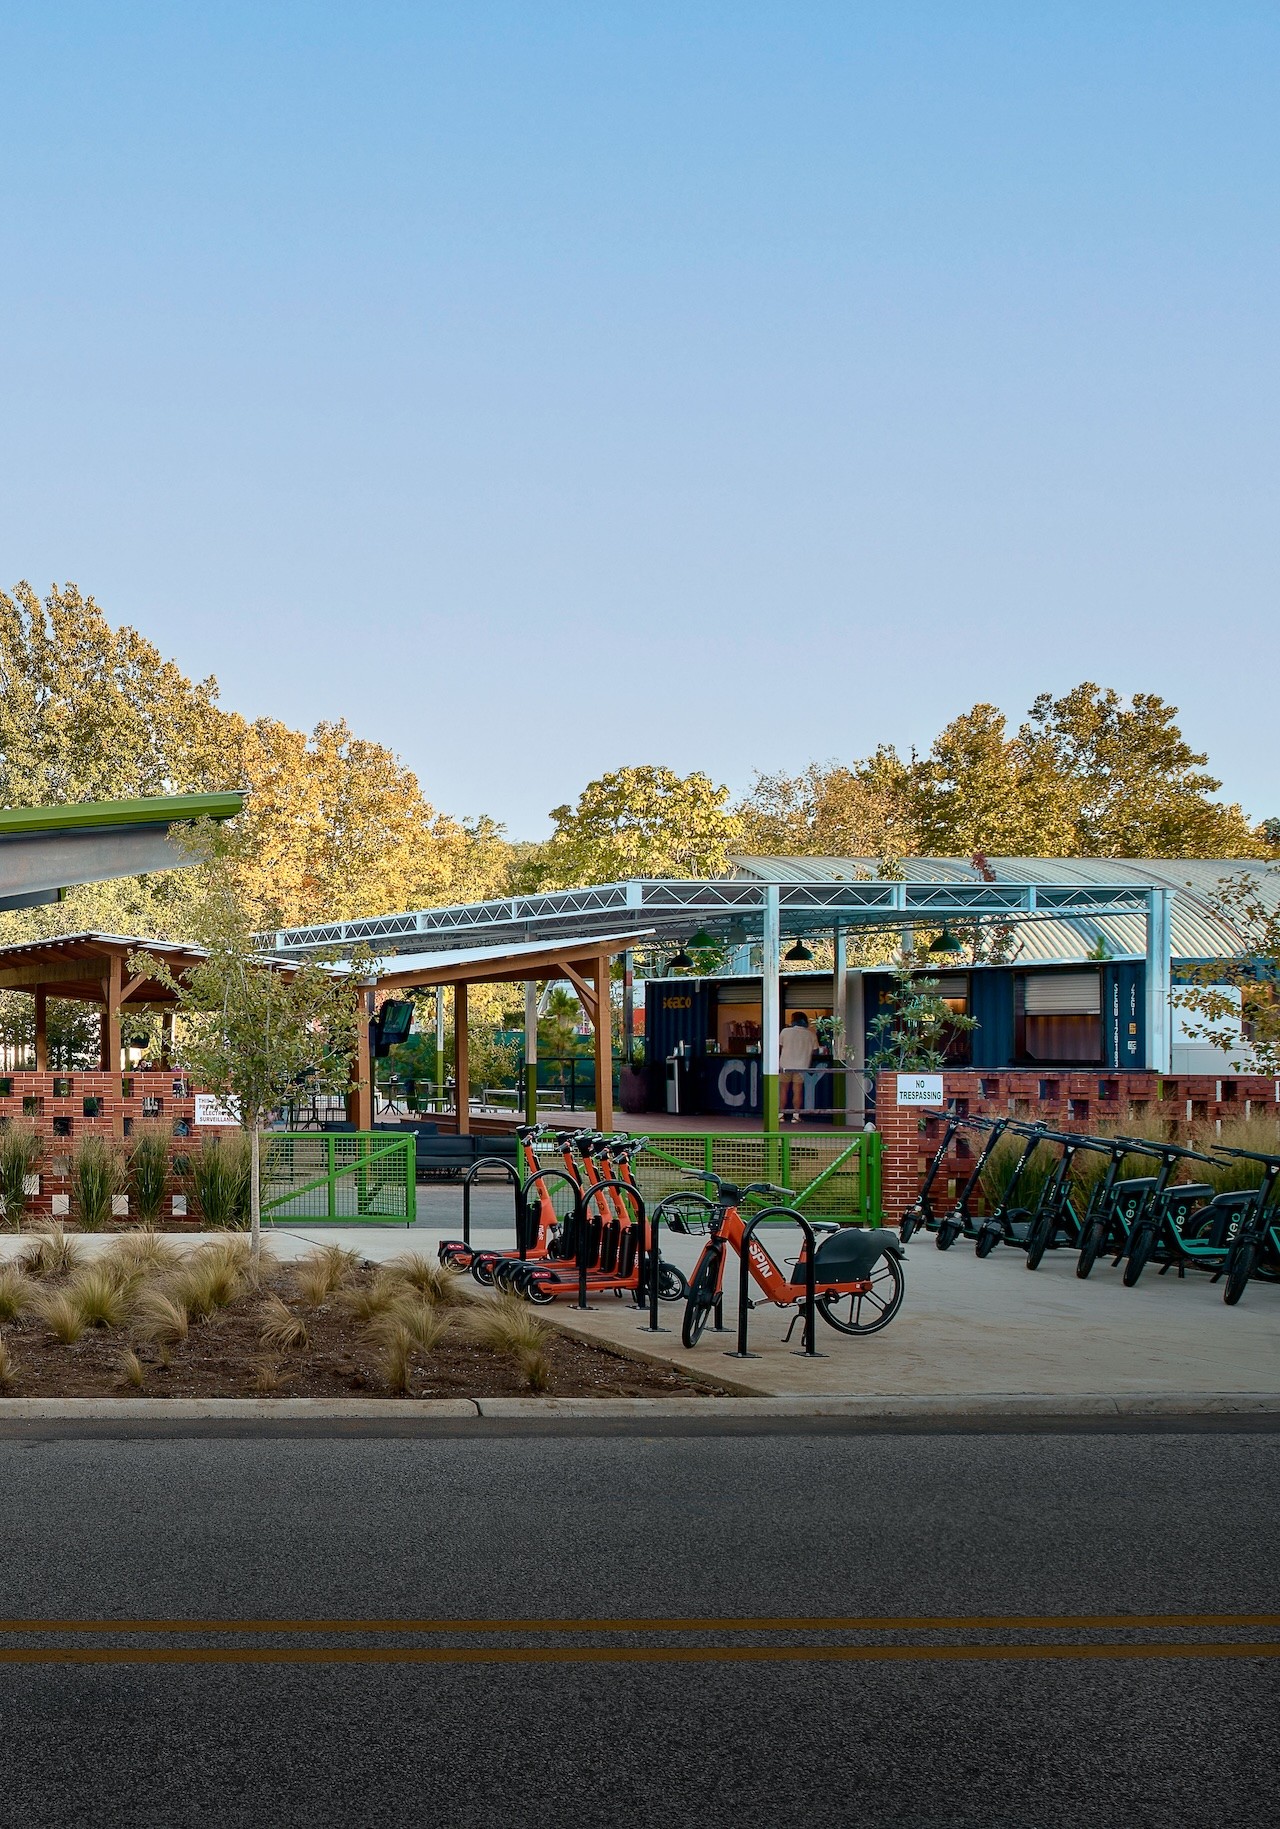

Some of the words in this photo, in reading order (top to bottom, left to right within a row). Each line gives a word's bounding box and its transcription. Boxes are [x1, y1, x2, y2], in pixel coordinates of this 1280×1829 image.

[718, 1059, 829, 1110] CIY
[899, 1091, 942, 1100] TRESPASSING
[915, 1080, 925, 1088] NO
[1226, 1213, 1241, 1241] veo
[749, 1243, 773, 1279] SPIN
